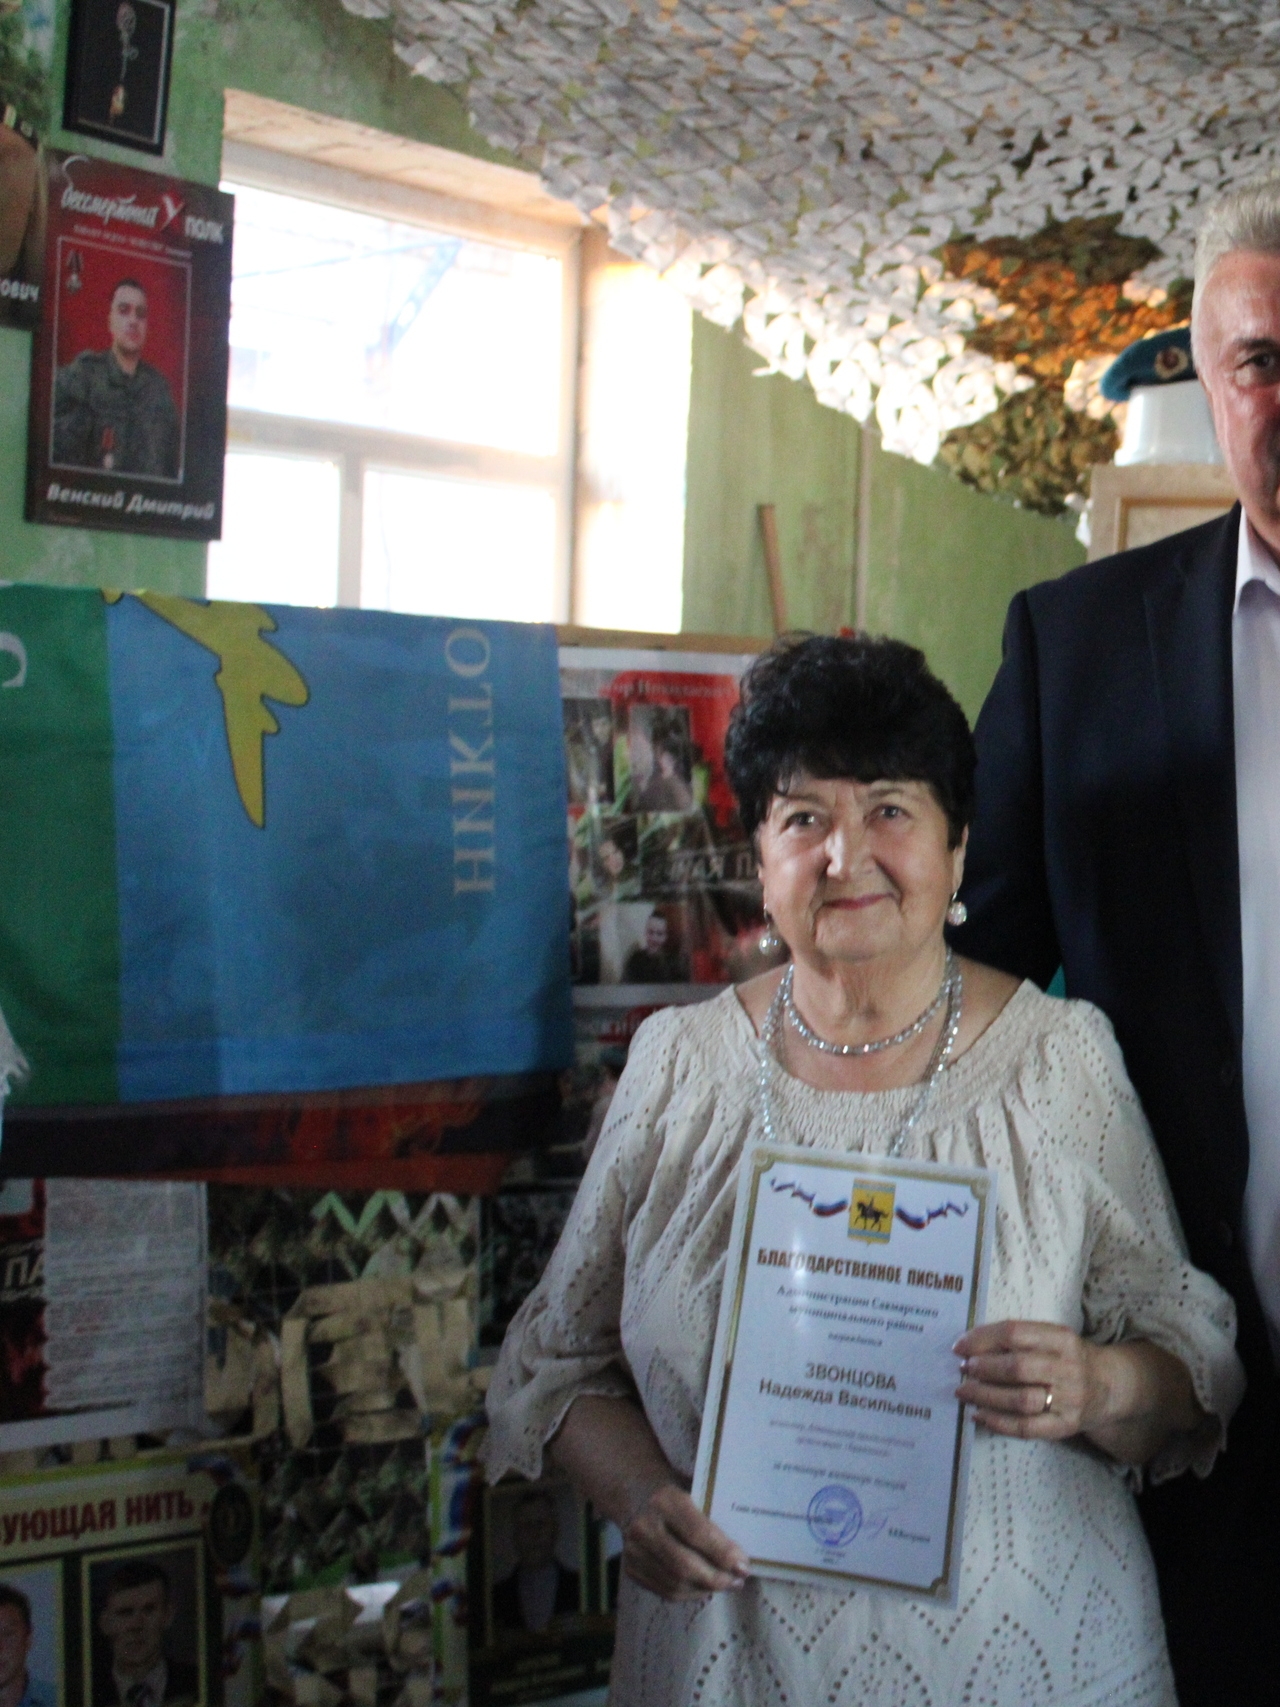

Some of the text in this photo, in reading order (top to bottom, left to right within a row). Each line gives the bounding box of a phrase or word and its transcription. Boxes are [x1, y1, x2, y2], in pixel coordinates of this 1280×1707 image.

[47, 483, 216, 521] Венский Дмитрий
[758, 1247, 964, 1293] БЛАГОДАРСТВЕННОЕ ПИСЬМО
[805, 1362, 897, 1392] ЗВОНЦОВА
[758, 1378, 932, 1420] Надежда Васильевна
[0, 1490, 194, 1546] УЮЩАЯ НИТЬ
